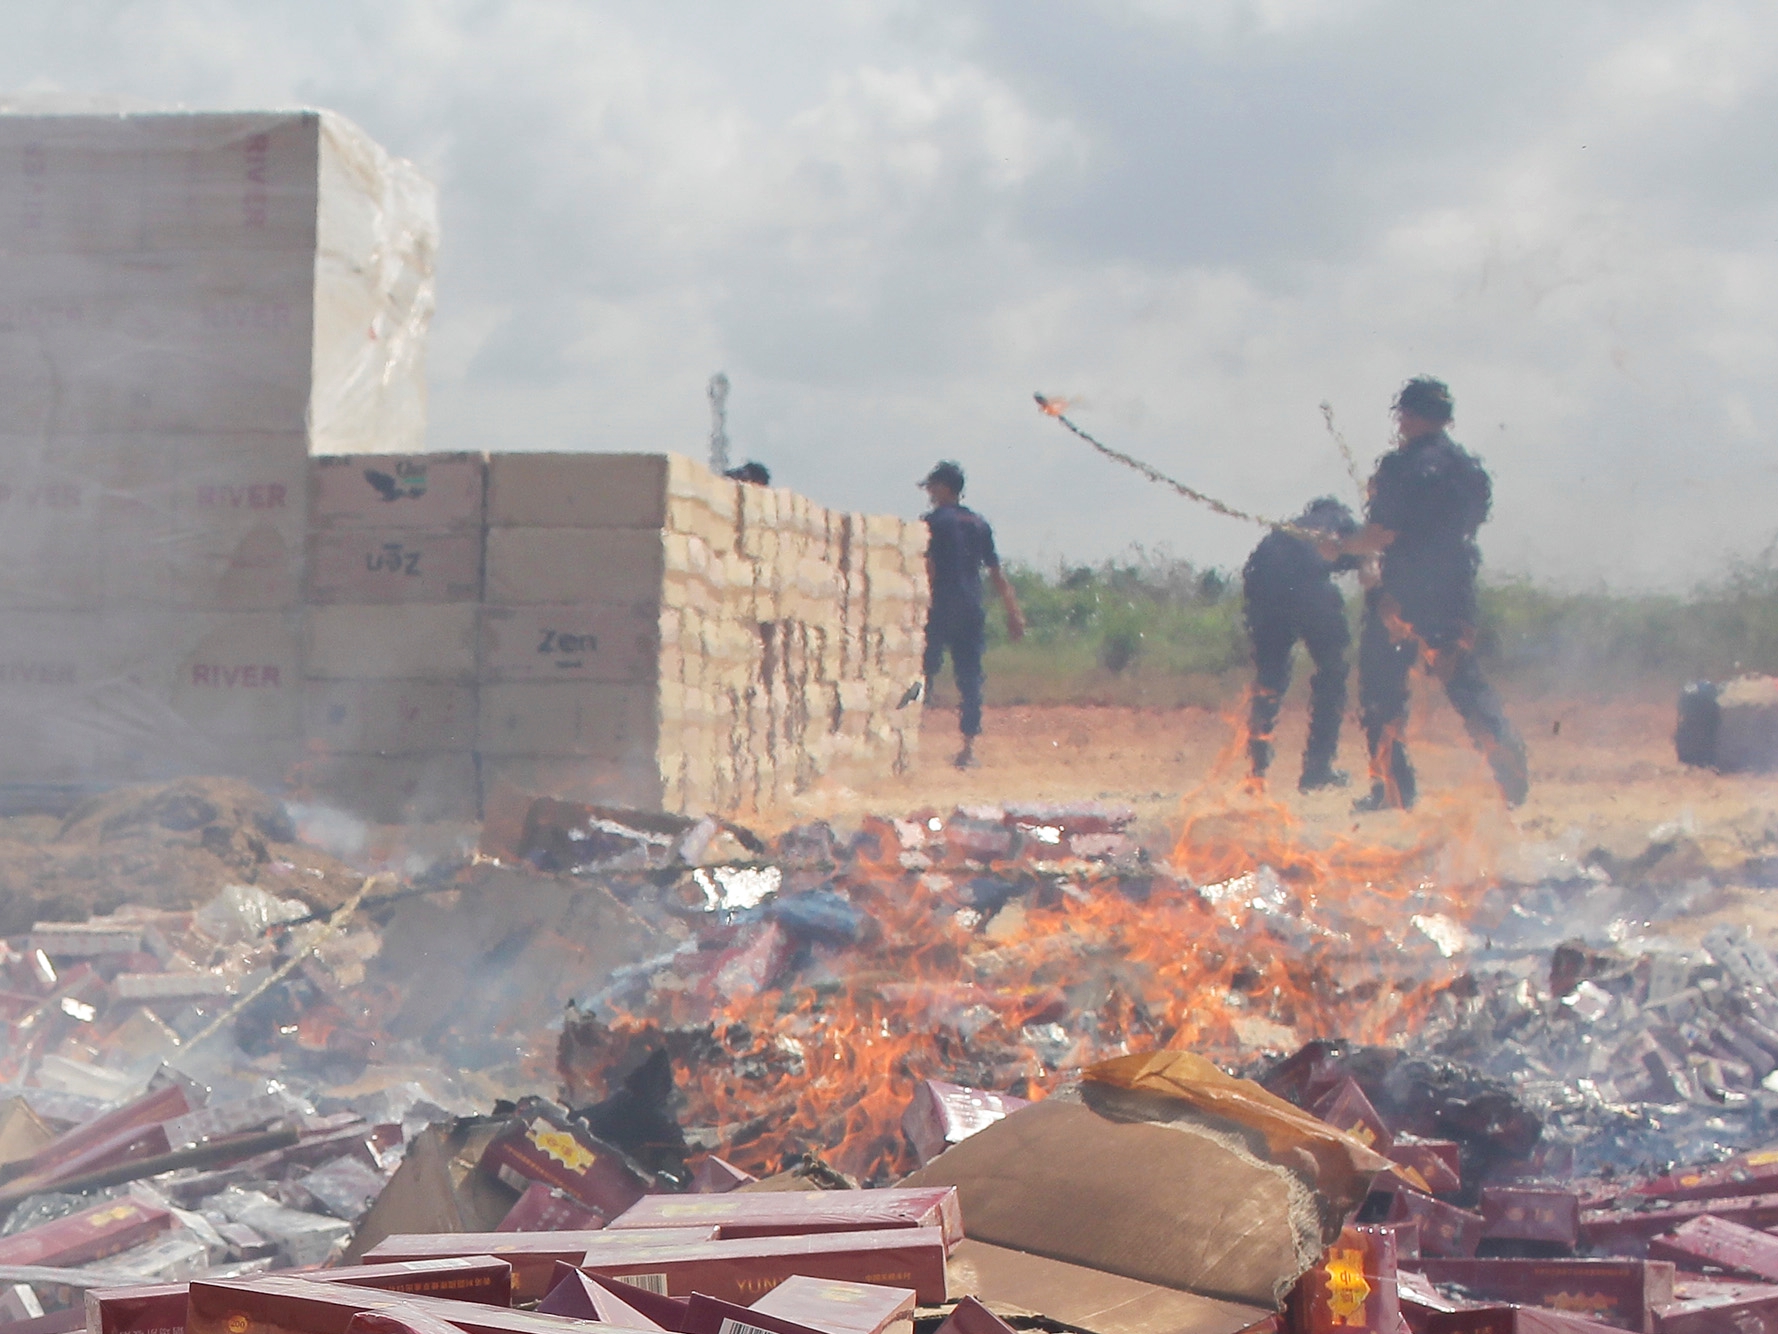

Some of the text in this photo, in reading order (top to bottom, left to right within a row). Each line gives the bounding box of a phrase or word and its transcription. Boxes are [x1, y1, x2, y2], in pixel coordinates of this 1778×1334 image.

[195, 483, 288, 508] RIVER
[537, 628, 598, 655] Zen
[192, 664, 281, 688] RIVER
